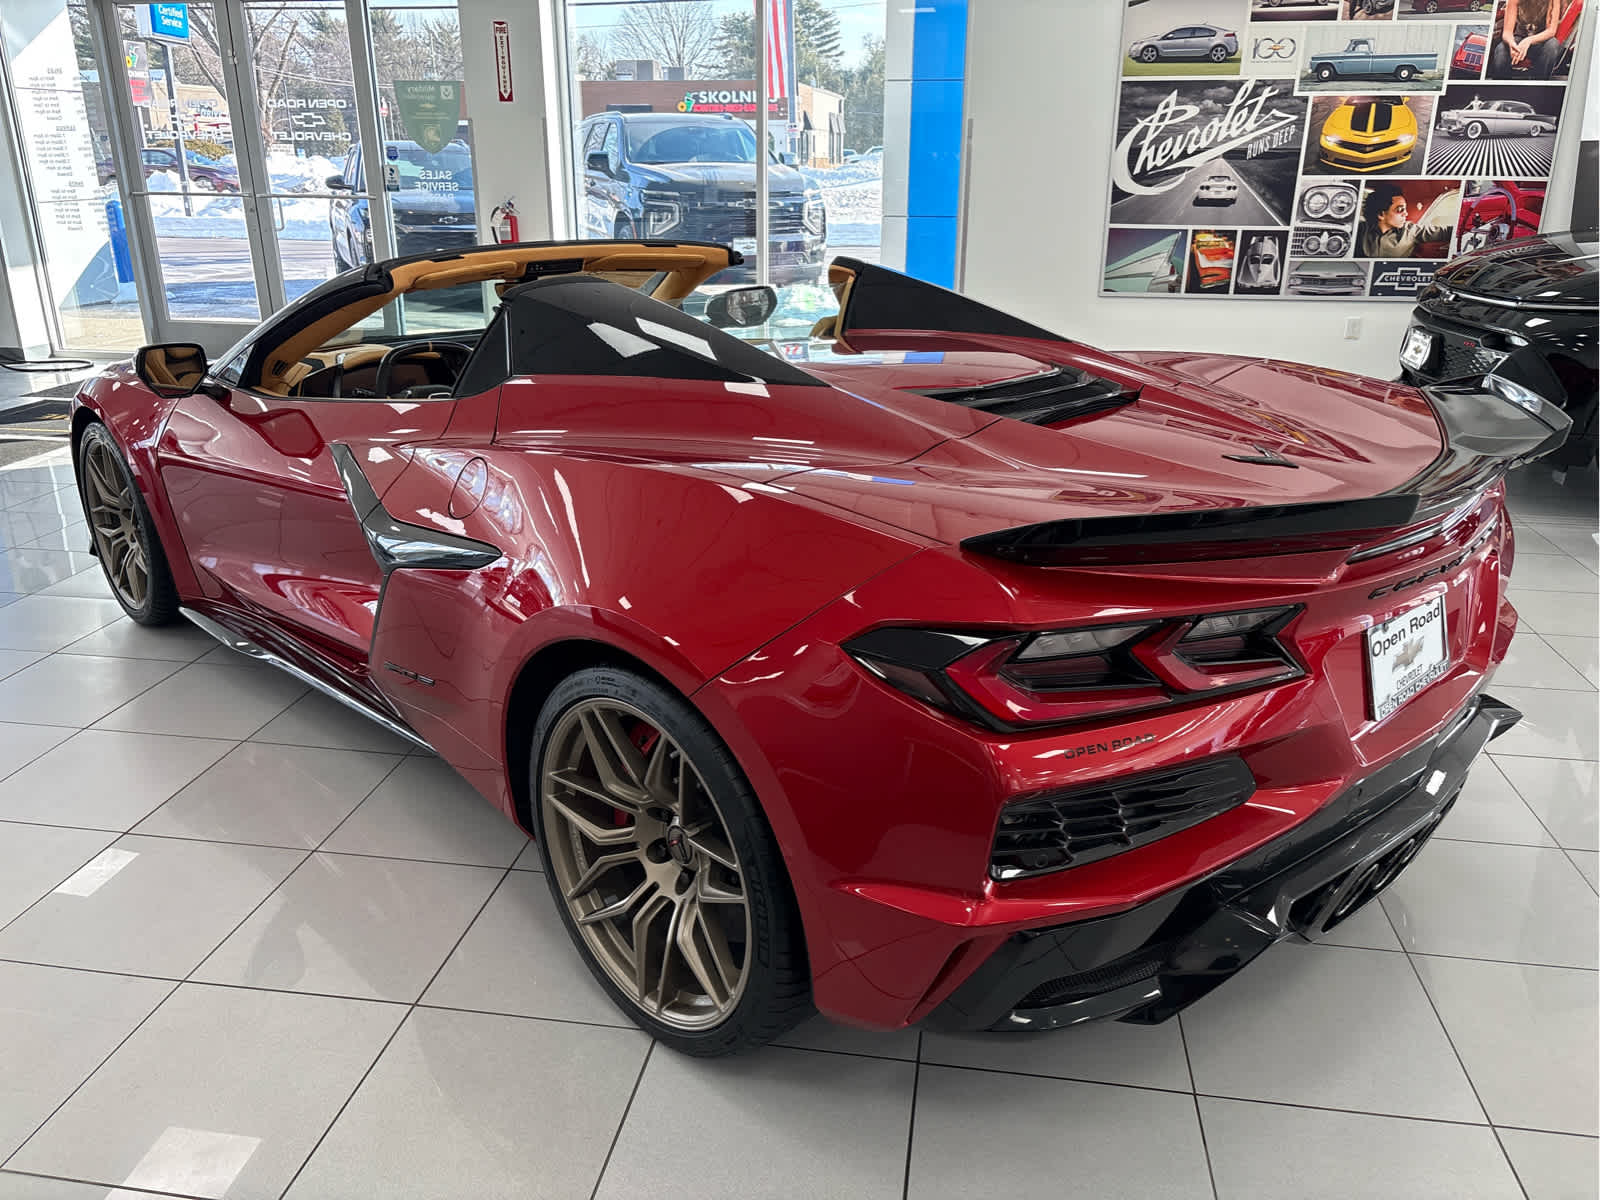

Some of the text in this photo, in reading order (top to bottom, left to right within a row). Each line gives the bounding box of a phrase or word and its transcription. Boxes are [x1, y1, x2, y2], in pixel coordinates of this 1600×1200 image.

[161, 15, 183, 29] Service
[495, 26, 506, 34] FIRE
[499, 36, 508, 94] EXTINGUISHER
[1112, 79, 1298, 194] Chevrolet
[1246, 124, 1296, 160] RUNS DEEP
[1372, 603, 1440, 657] Open Road
[1063, 733, 1155, 759] OPEN ROAD
